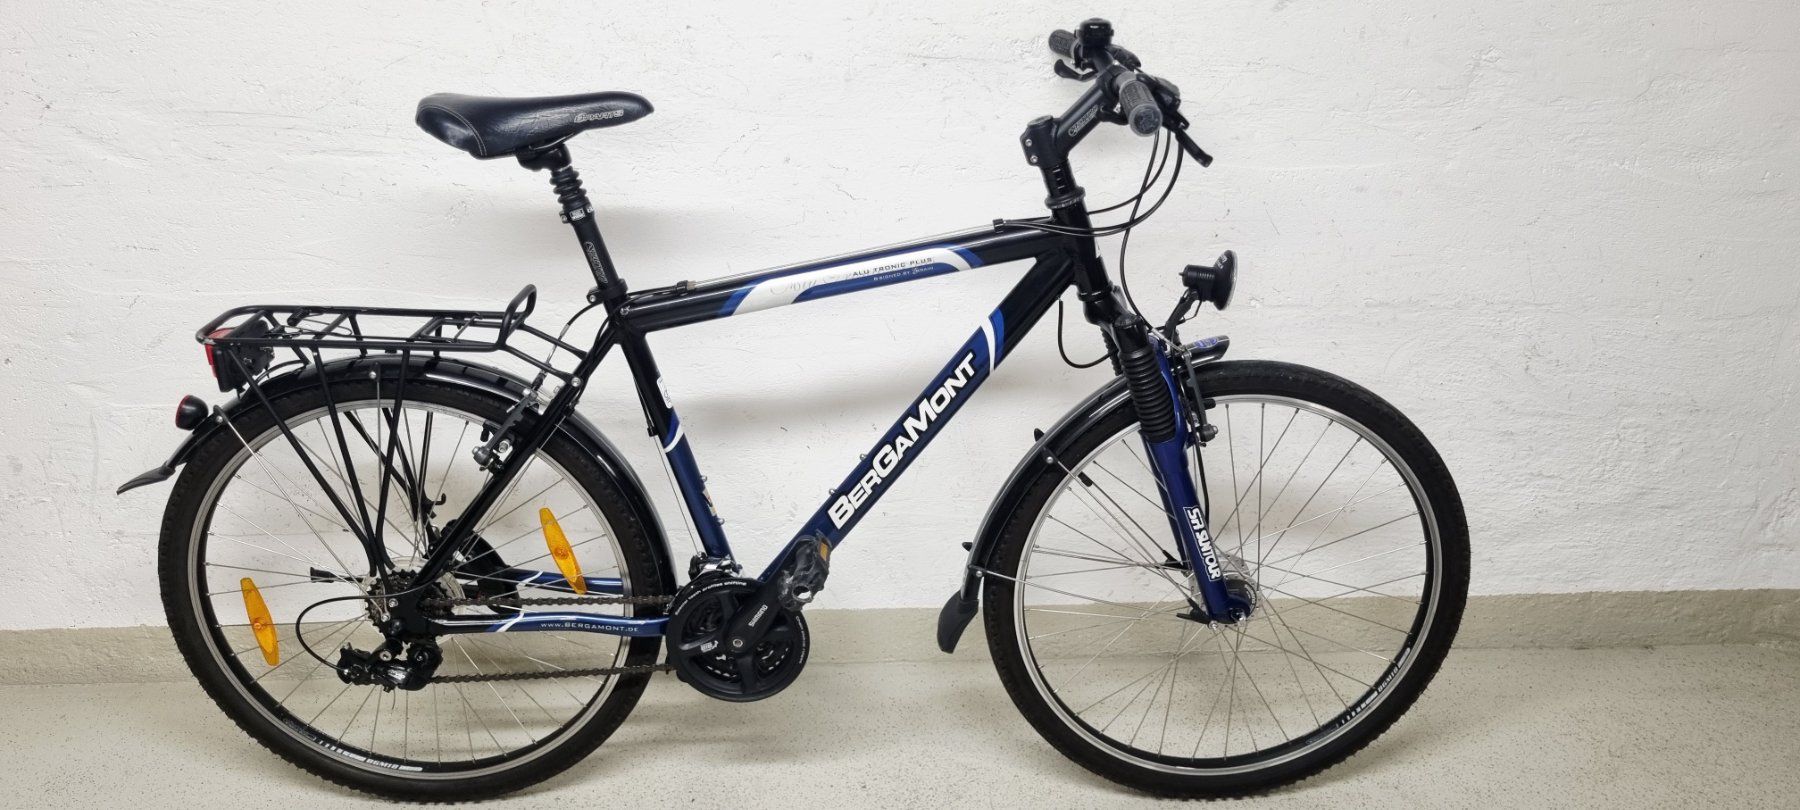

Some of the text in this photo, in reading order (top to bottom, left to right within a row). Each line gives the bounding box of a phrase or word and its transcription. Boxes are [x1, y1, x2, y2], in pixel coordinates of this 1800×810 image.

[853, 269, 870, 277] ALU
[874, 262, 906, 273] TRONIC
[910, 257, 933, 266] PLUS
[1187, 507, 1221, 579] SR SUNTOUR
